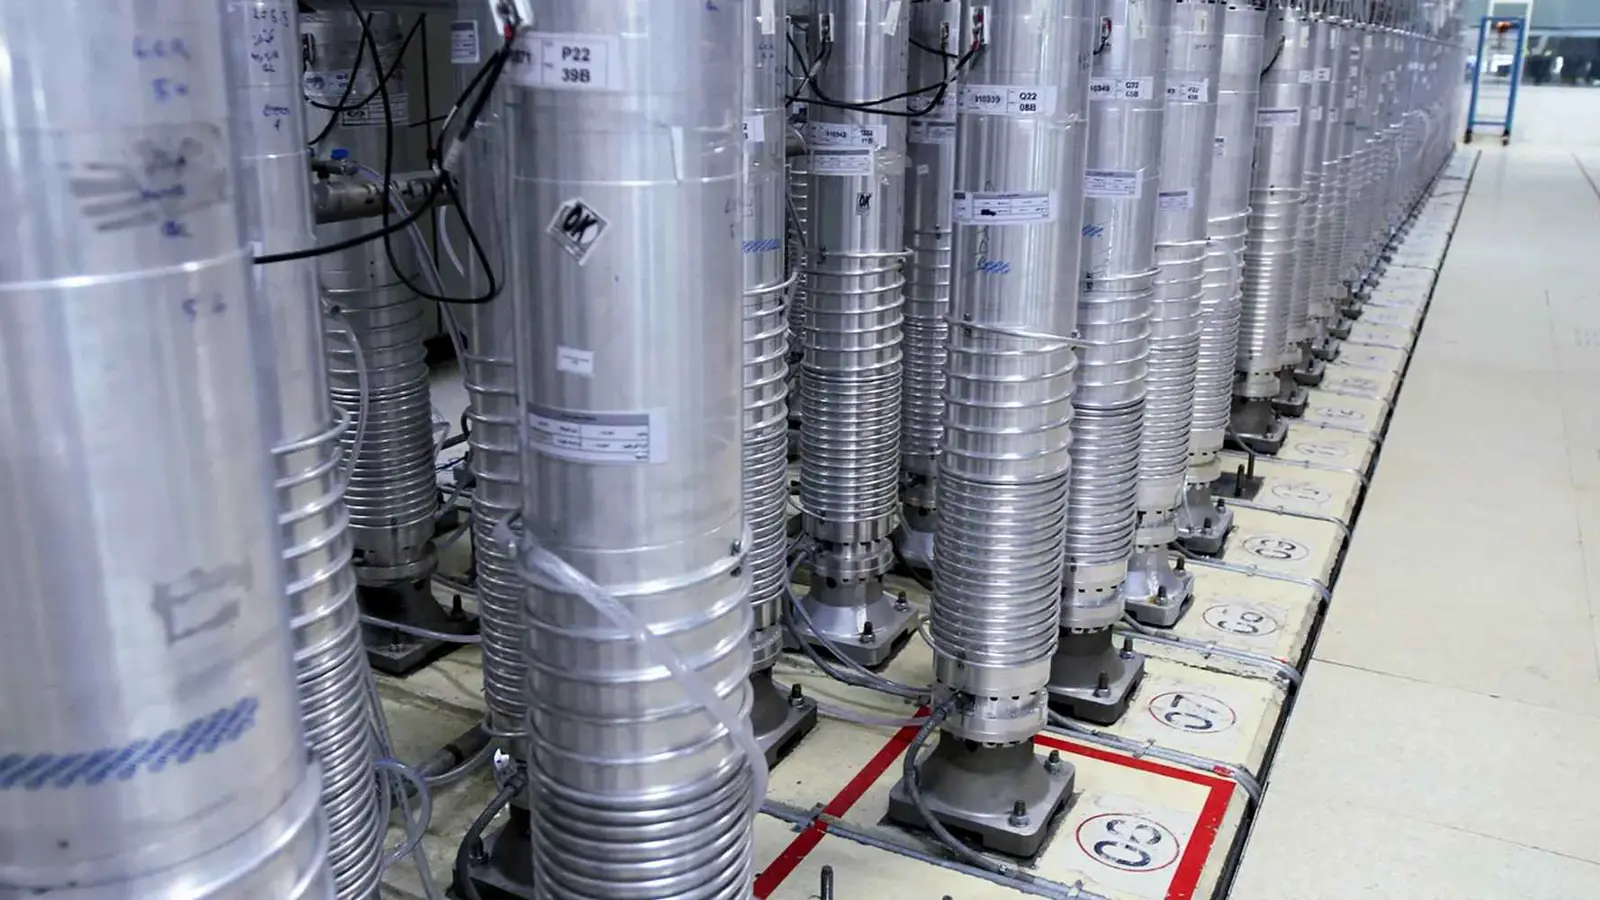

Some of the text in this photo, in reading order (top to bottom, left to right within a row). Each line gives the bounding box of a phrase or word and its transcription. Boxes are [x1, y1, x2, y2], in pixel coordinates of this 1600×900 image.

[562, 45, 591, 62] P22
[1019, 92, 1037, 101] Q22
[563, 201, 598, 243] OK
[1163, 693, 1219, 731] 07
